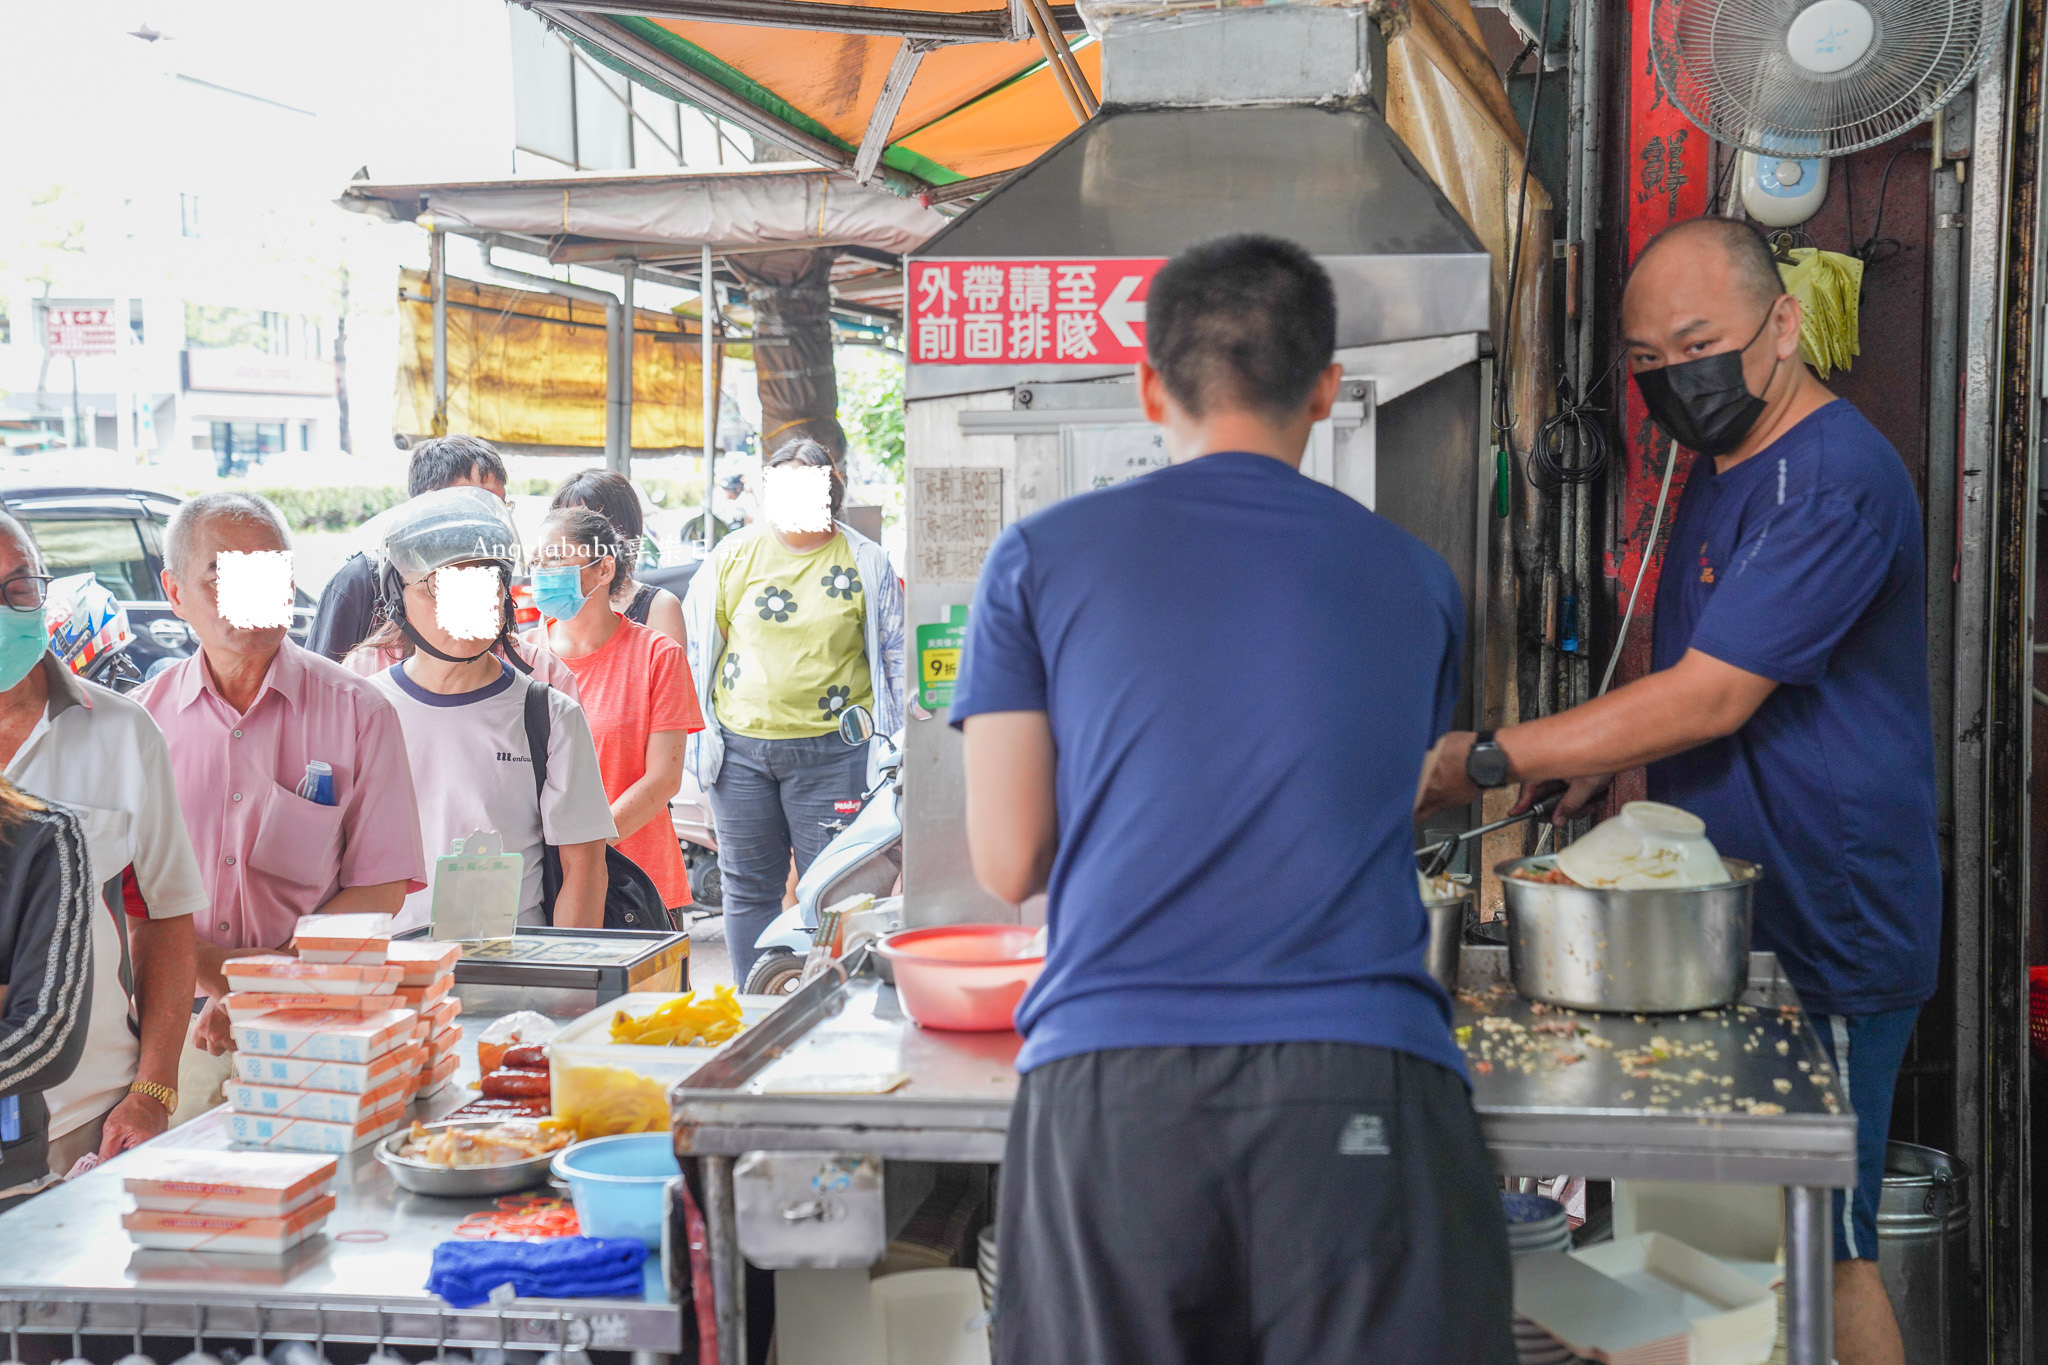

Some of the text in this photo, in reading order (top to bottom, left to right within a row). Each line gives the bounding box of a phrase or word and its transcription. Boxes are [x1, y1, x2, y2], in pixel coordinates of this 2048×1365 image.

[917, 265, 1098, 313] 外帶請至
[917, 312, 1098, 360] 前面排隊
